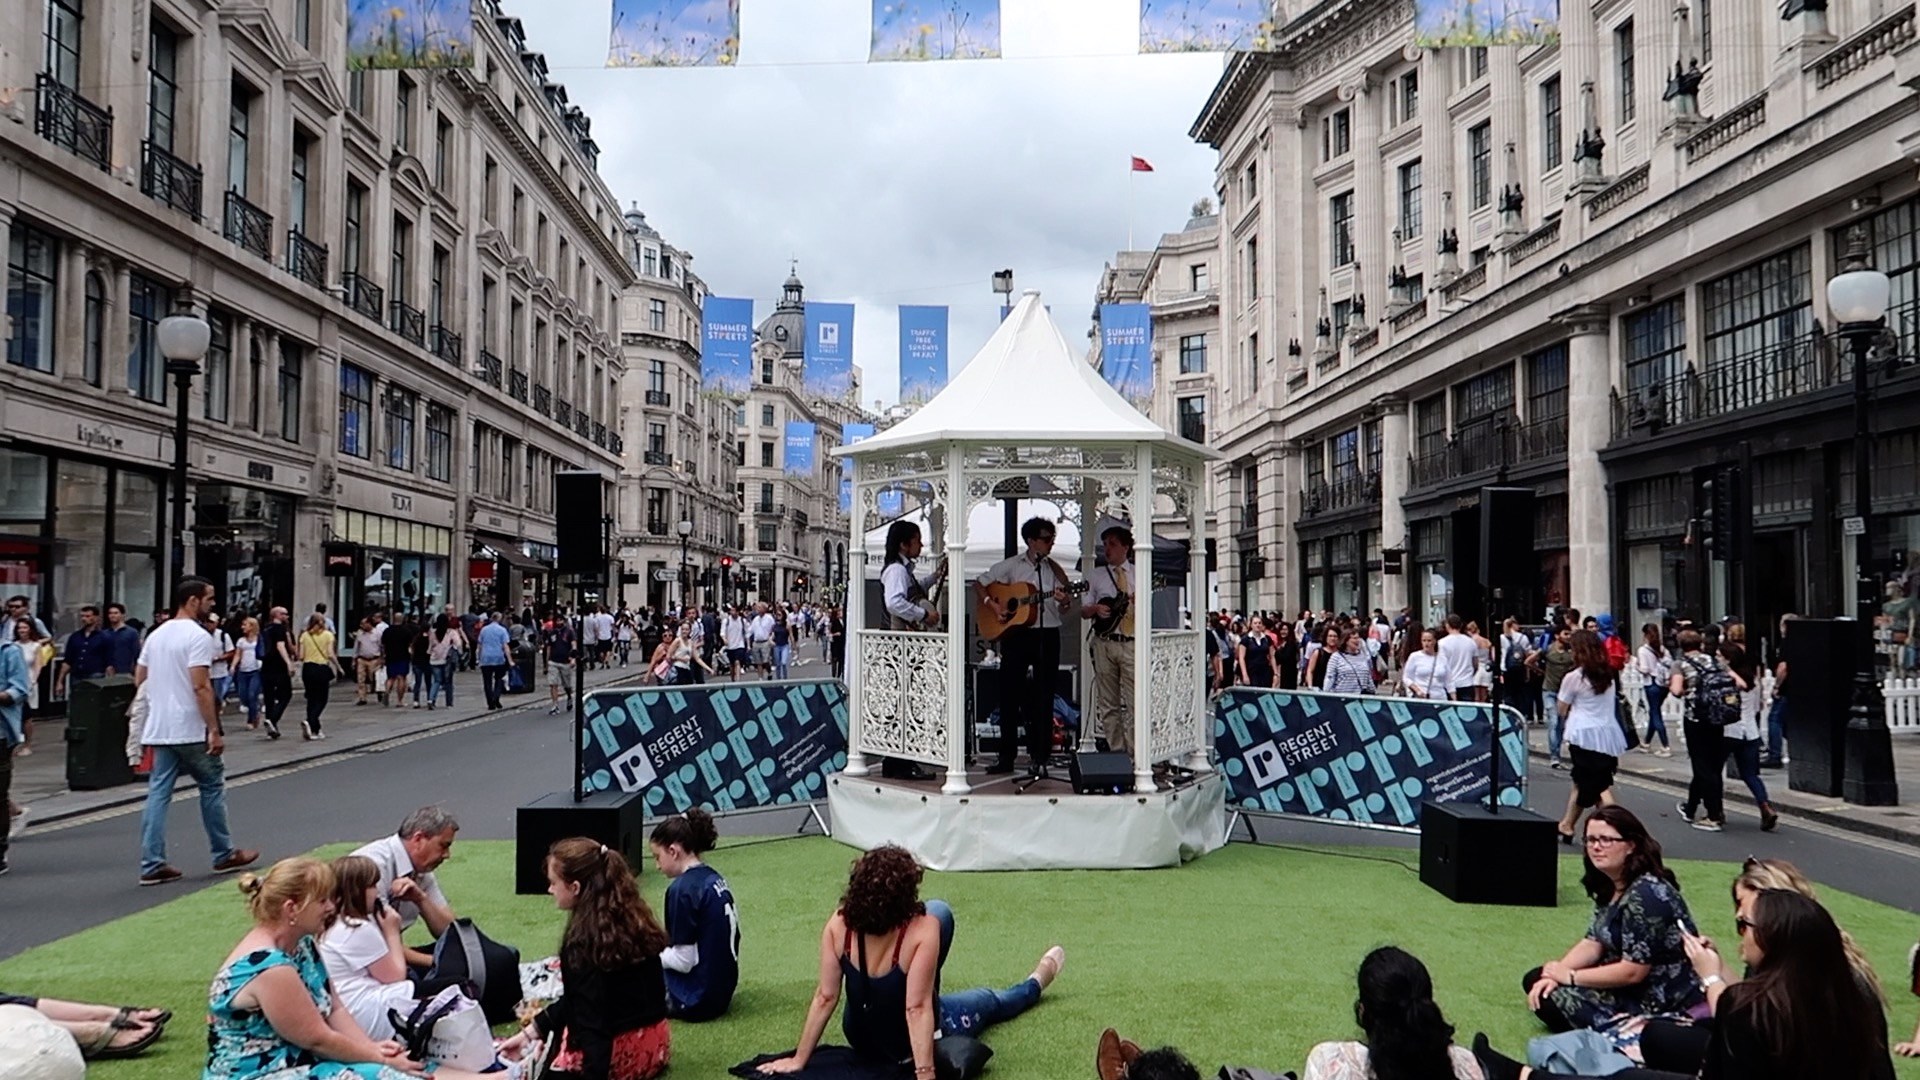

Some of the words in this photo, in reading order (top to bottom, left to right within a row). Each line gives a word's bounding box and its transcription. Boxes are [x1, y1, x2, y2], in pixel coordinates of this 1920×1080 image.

[708, 323, 747, 332] SUMMER
[708, 331, 747, 341] STREETS
[1106, 328, 1144, 337] SUMMER
[1106, 337, 1144, 345] STREETS
[648, 715, 700, 756] REGENT
[1279, 721, 1333, 754] REGENT
[654, 727, 705, 768] STREET
[1285, 733, 1339, 766] STREET
